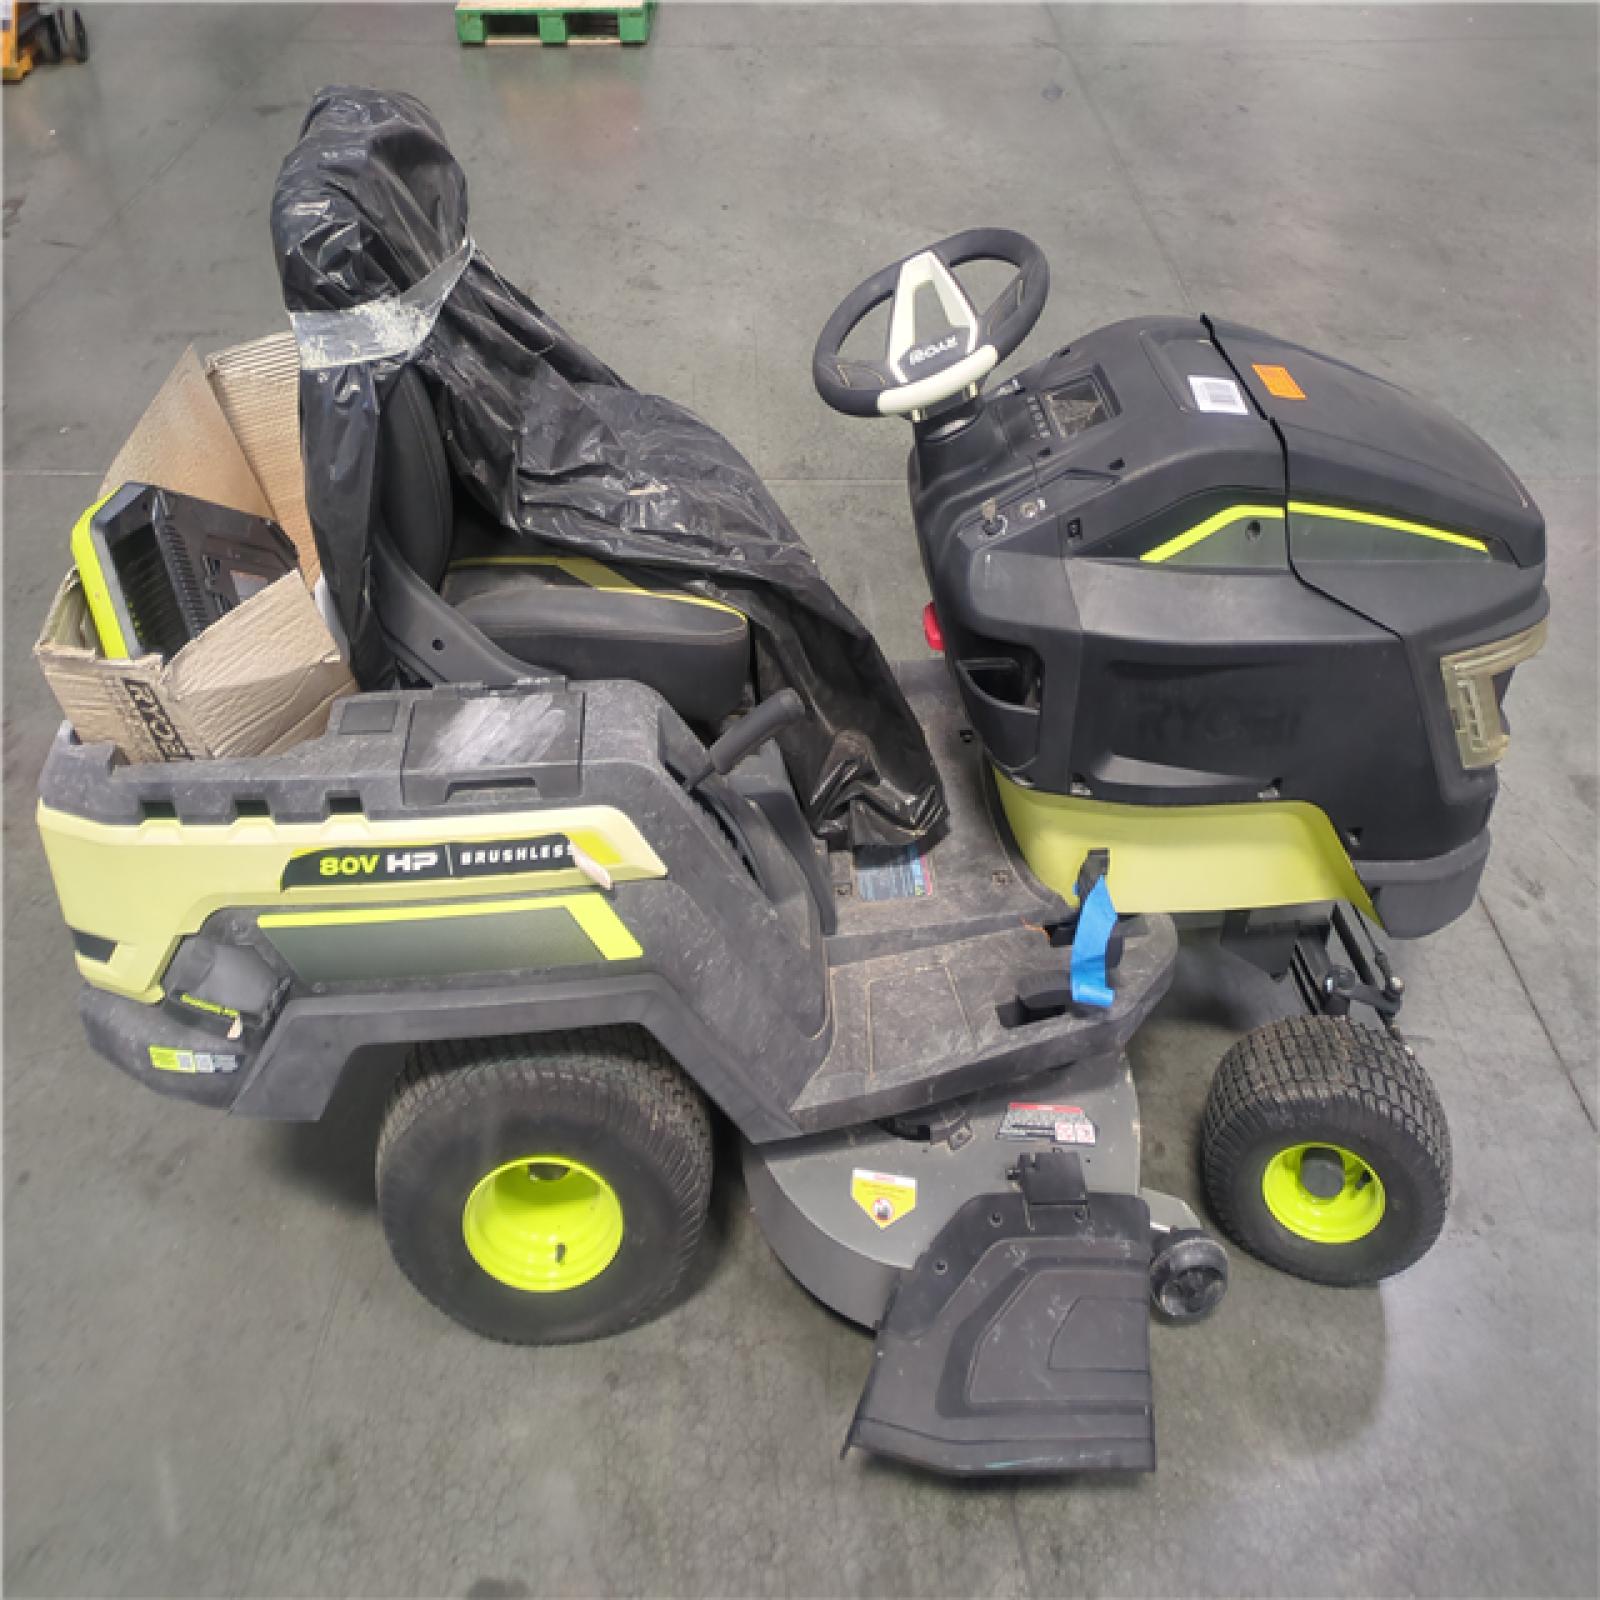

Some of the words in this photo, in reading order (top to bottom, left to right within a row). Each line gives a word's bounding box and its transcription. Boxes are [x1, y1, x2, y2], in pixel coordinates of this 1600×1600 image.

[122, 678, 194, 760] RYOB
[320, 855, 379, 875] 80V
[386, 850, 438, 873] HP
